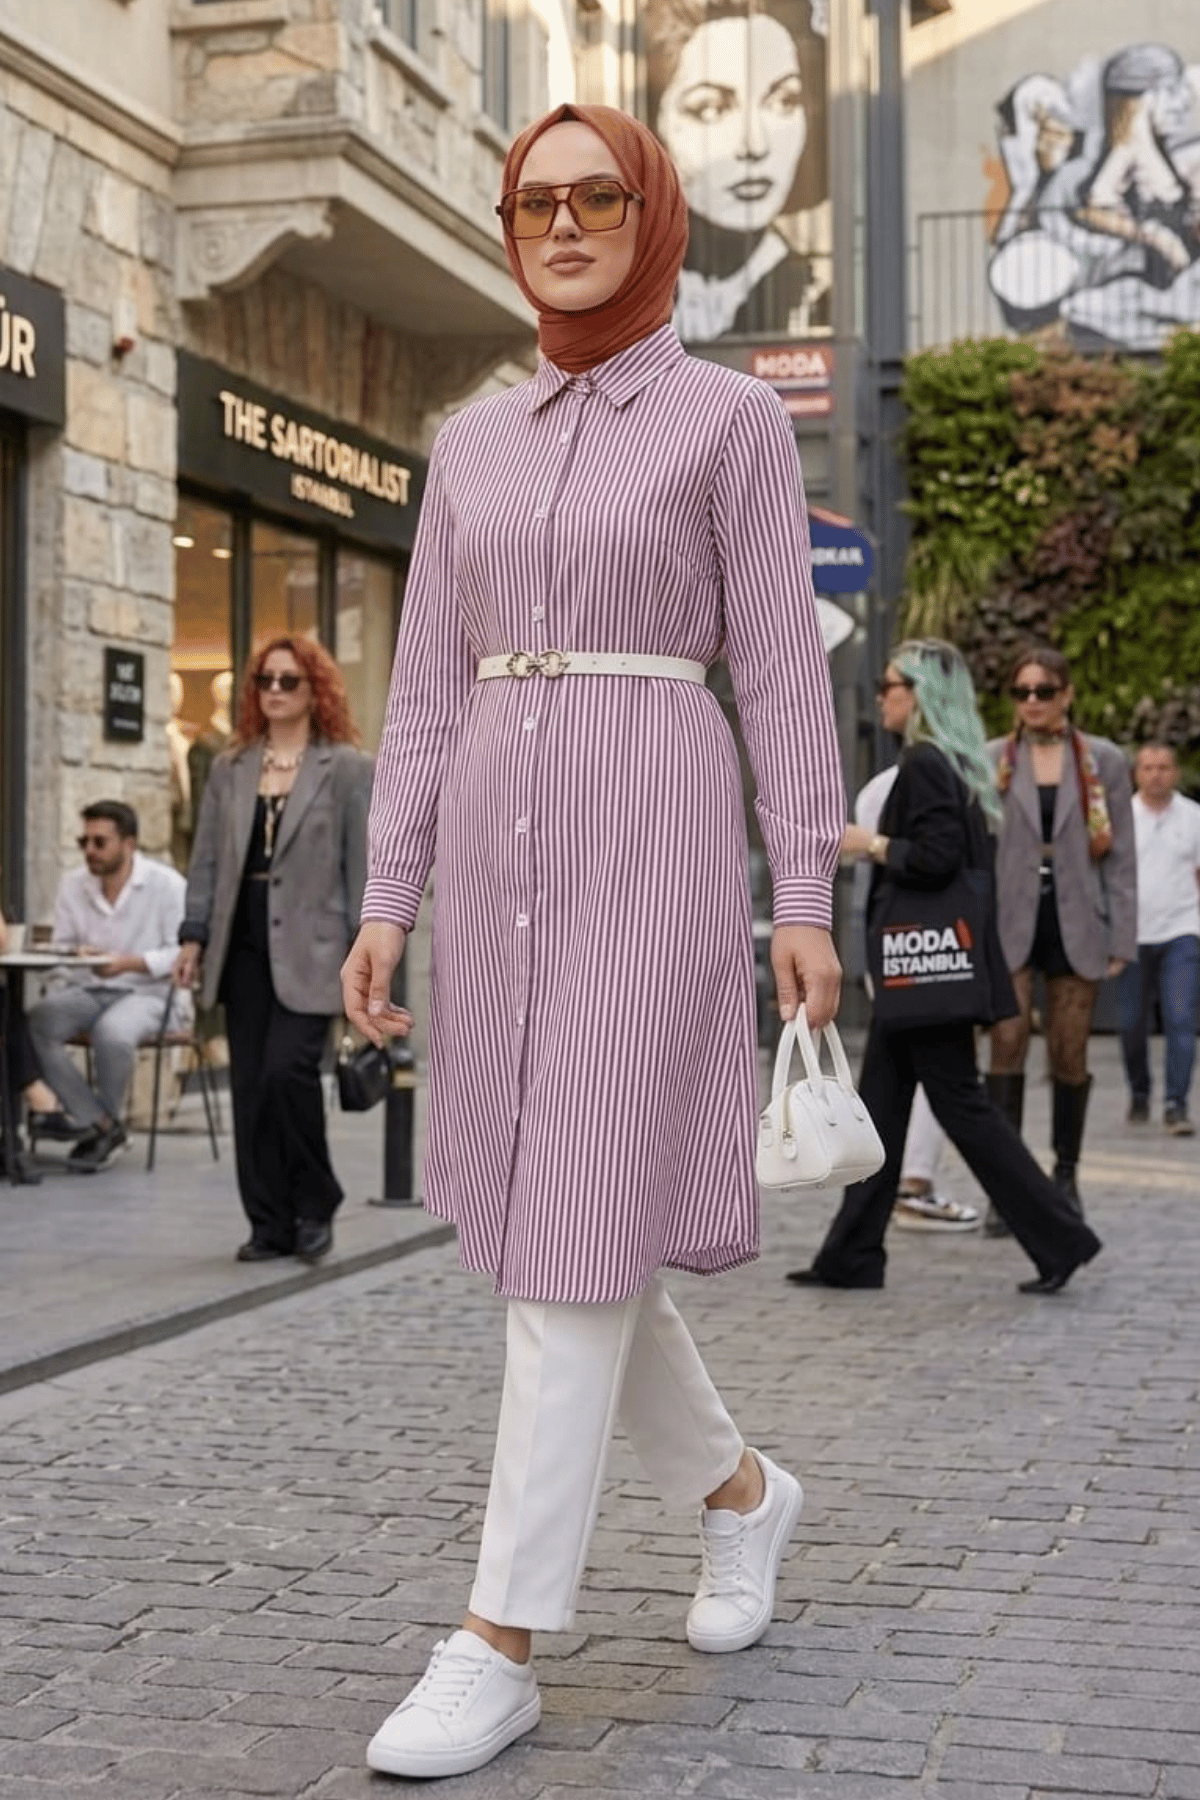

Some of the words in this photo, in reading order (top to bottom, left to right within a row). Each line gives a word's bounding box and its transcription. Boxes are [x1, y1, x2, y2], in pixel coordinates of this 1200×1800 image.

[756, 353, 826, 376] MODA
[219, 391, 268, 449] THE
[271, 414, 411, 506] SARTORIALIST
[883, 927, 960, 956] MODA
[883, 951, 974, 977] ISTANBUL
